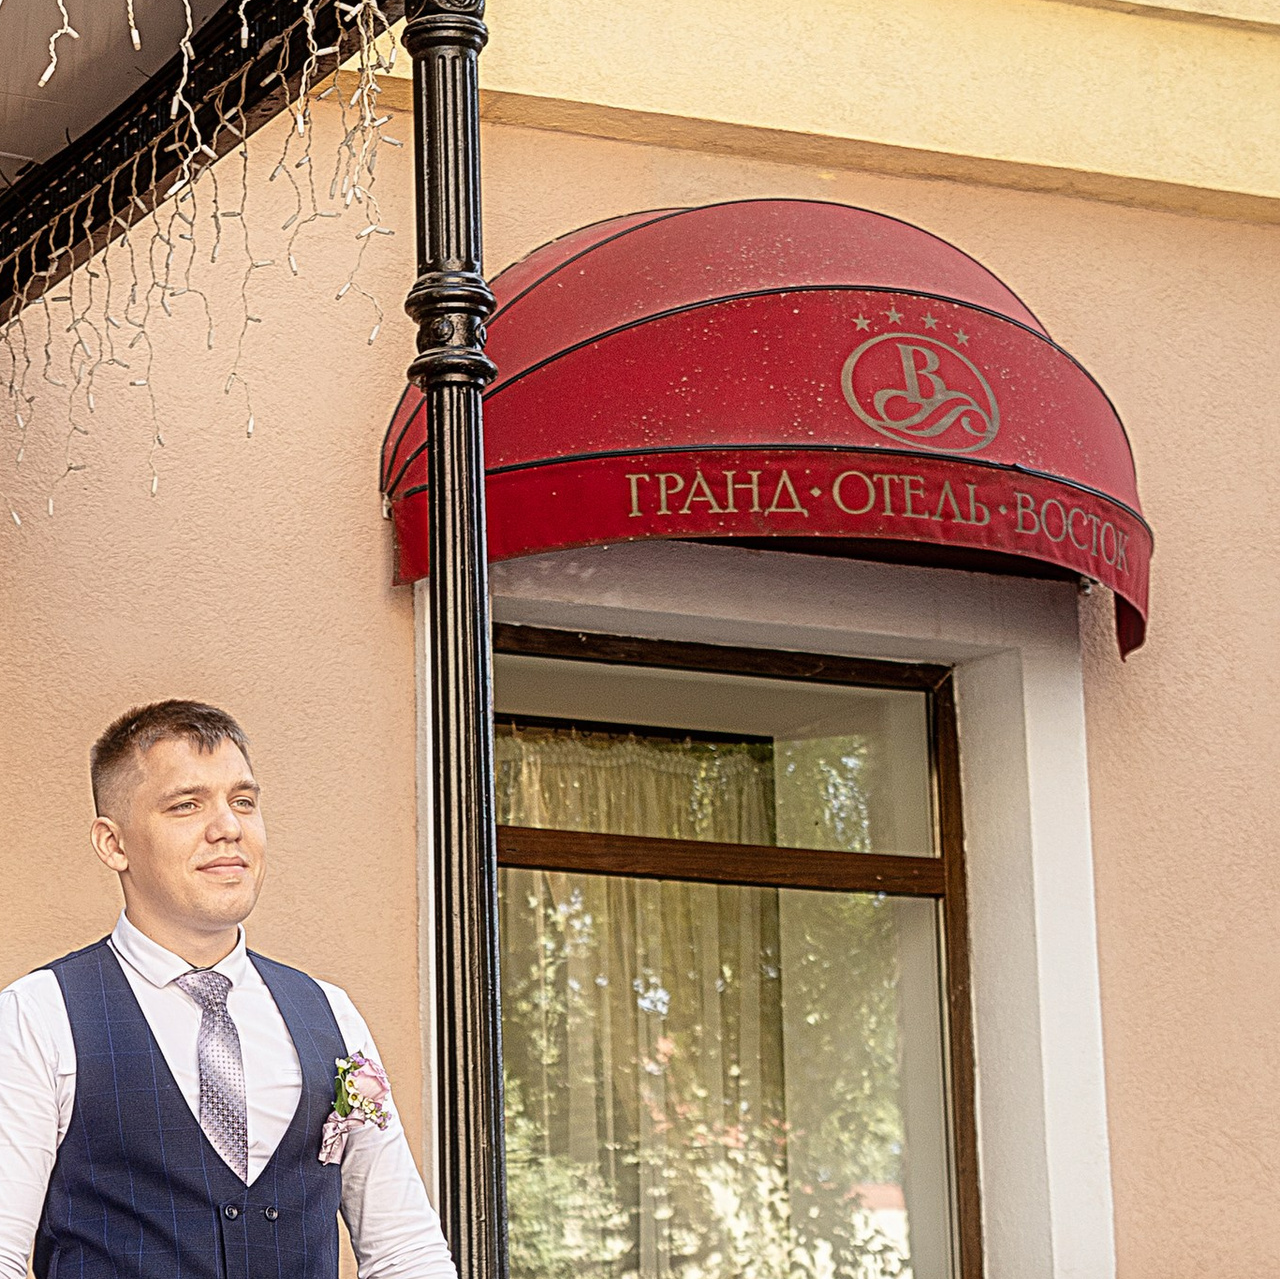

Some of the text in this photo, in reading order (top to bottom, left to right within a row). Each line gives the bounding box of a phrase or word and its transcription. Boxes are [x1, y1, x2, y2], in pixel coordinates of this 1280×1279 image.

[625, 470, 1130, 575] ГРАНД ОТЕЛЬ ВОСТОК
